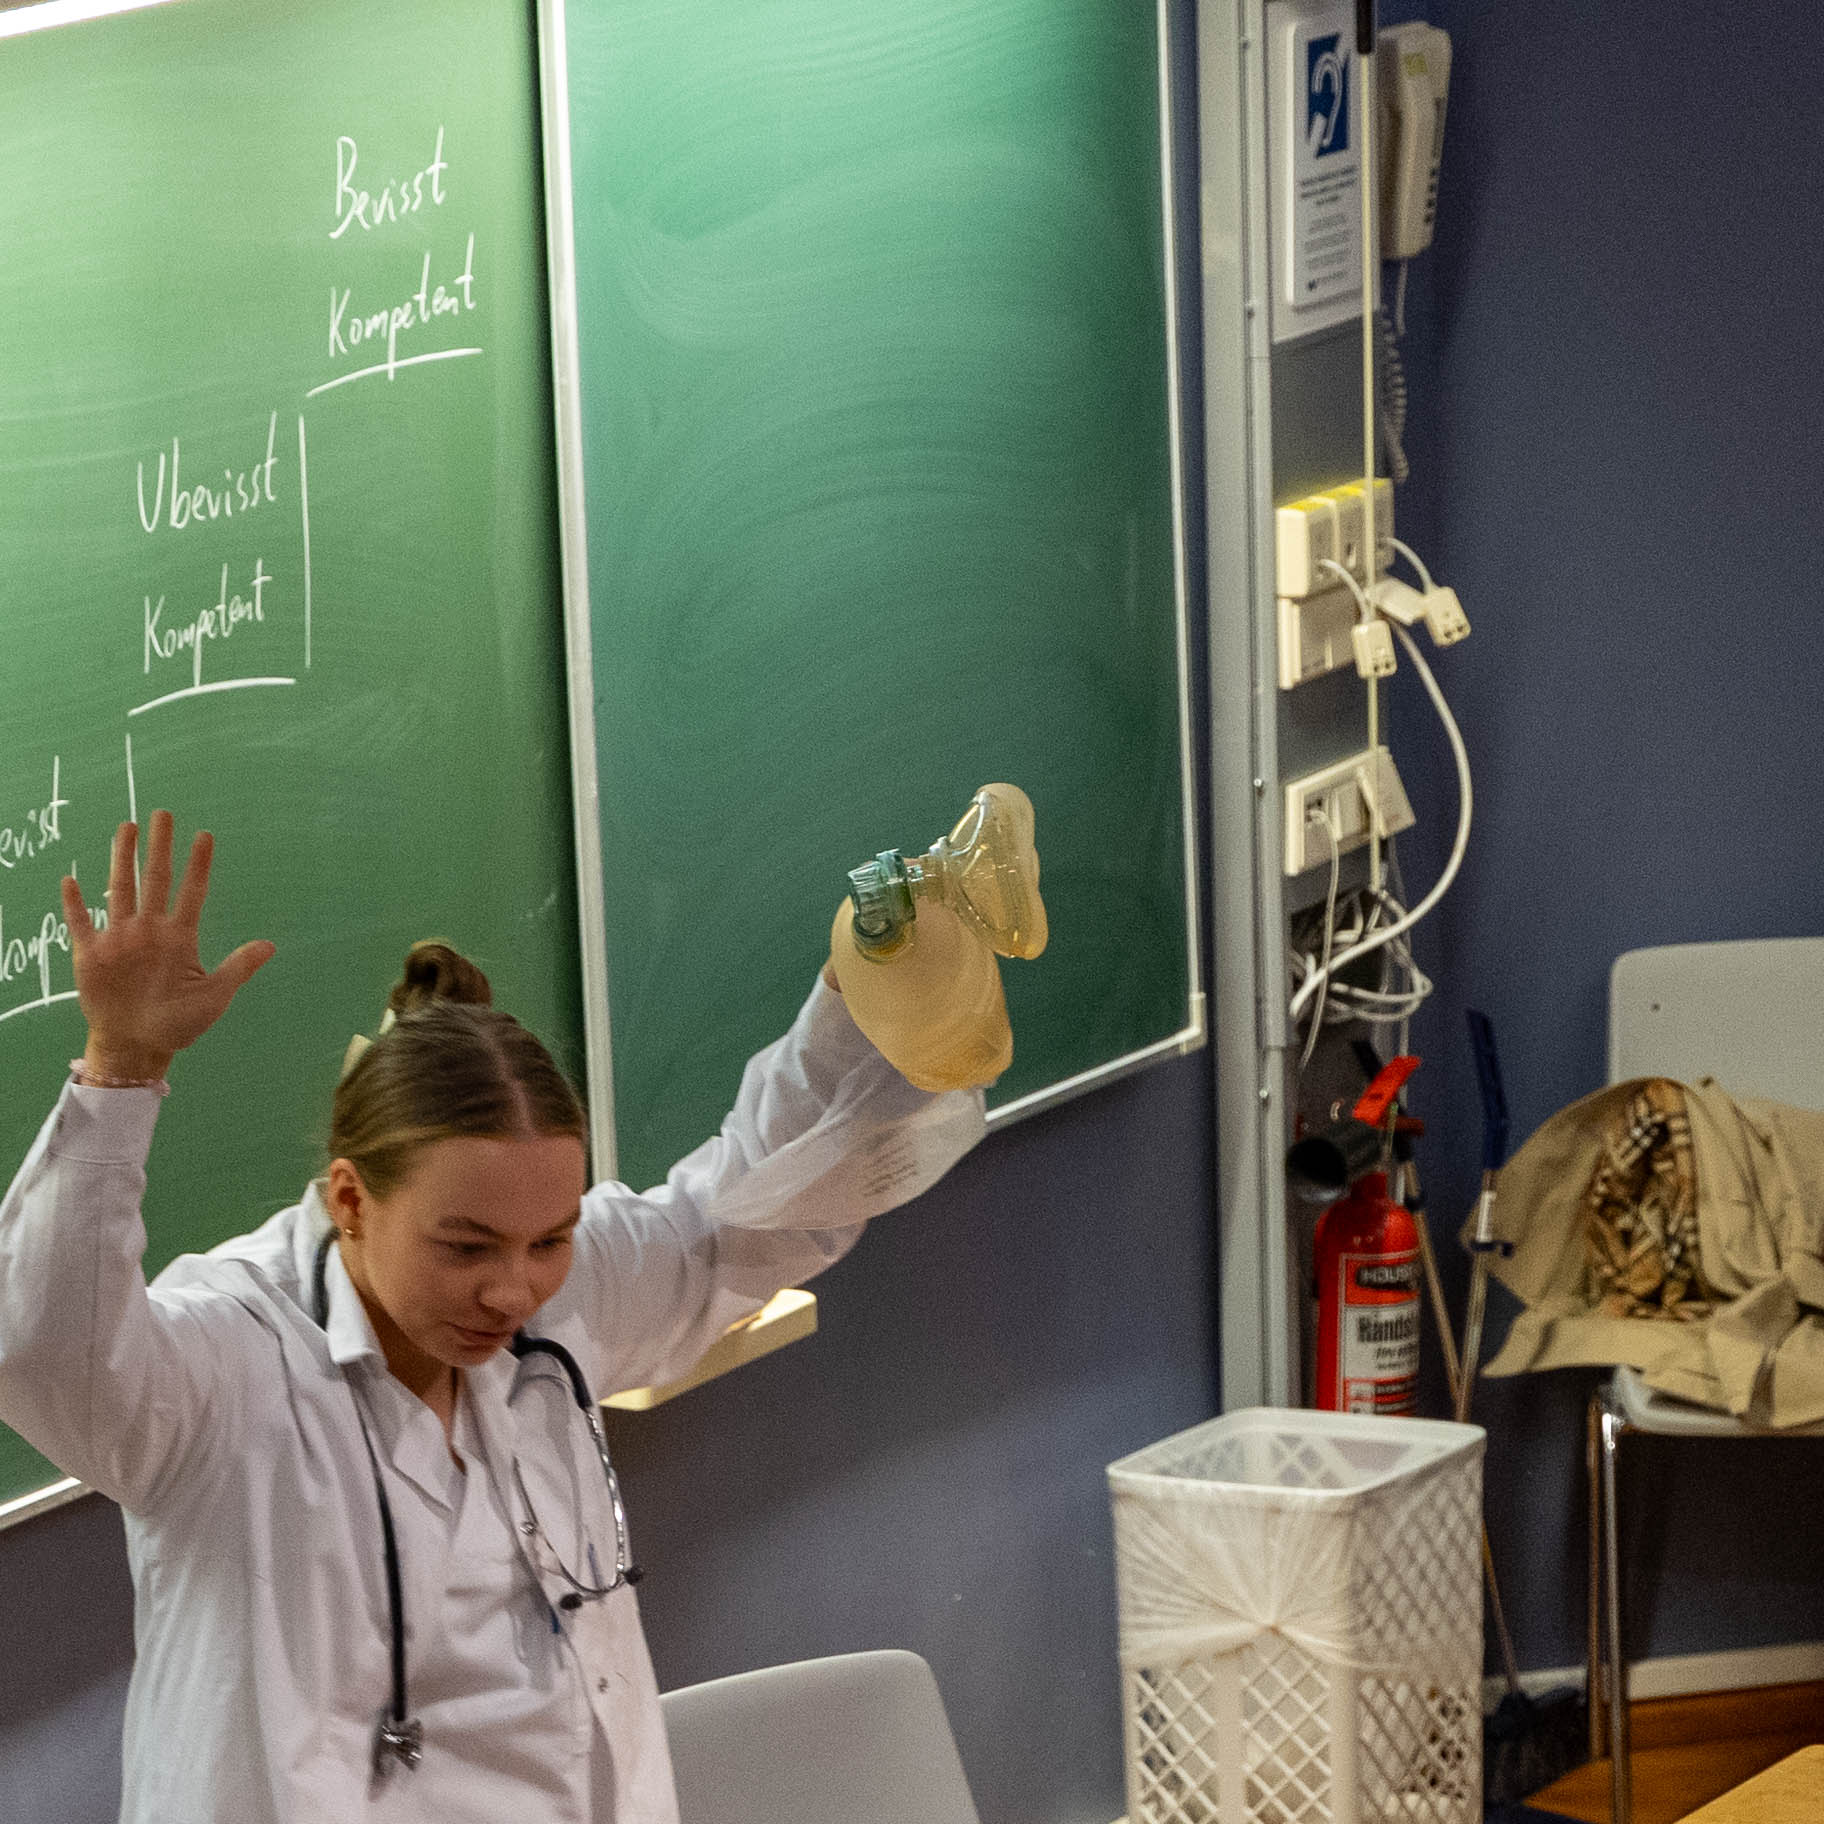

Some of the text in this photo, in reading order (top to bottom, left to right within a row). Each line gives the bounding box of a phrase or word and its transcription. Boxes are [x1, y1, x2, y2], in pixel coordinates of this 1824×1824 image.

[328, 124, 448, 239] Bevisst
[328, 231, 476, 381] Kompetent
[136, 410, 279, 533] Ubevisst
[143, 557, 273, 689] Kompetent
